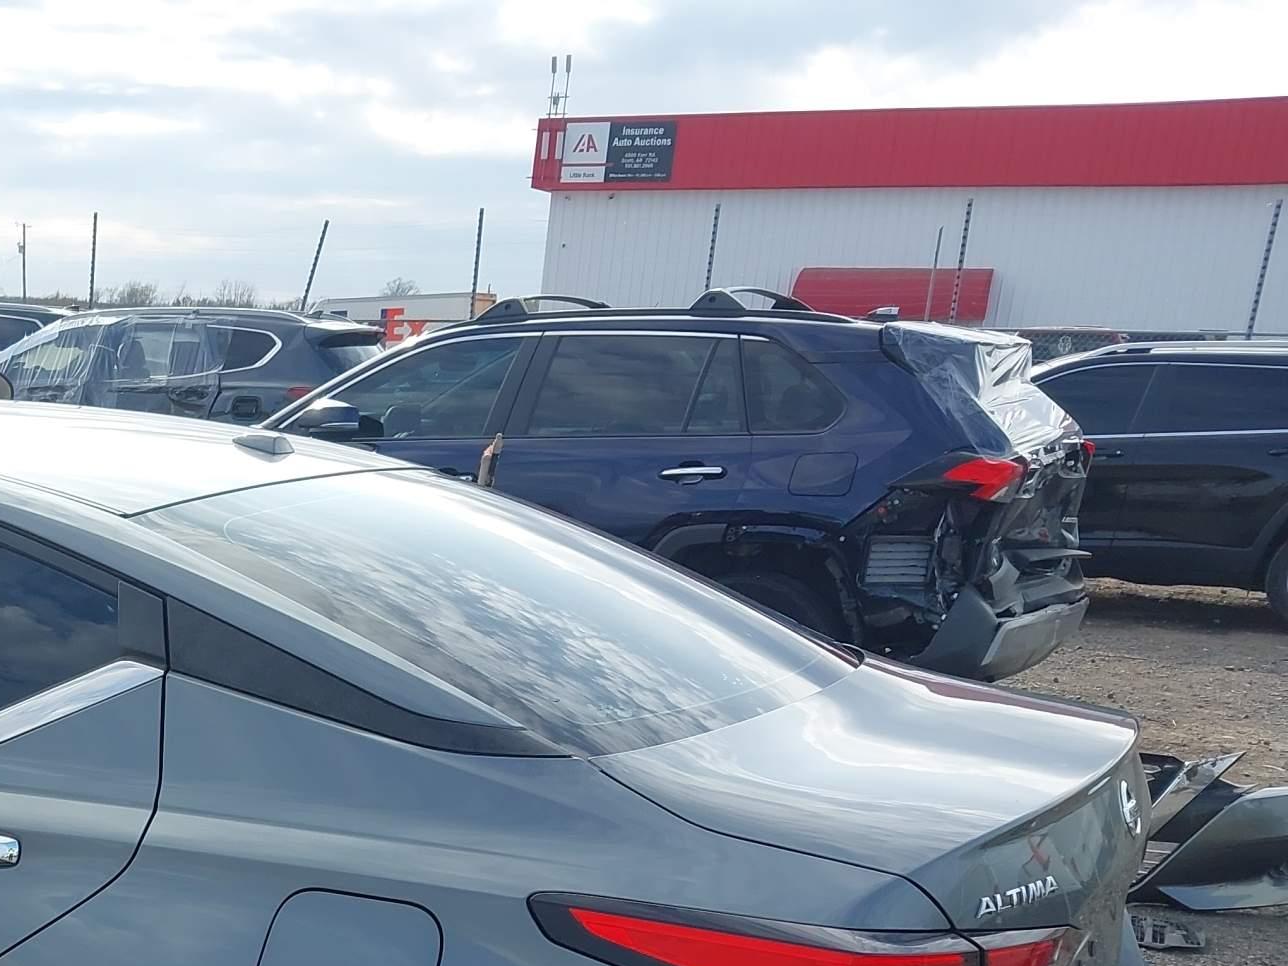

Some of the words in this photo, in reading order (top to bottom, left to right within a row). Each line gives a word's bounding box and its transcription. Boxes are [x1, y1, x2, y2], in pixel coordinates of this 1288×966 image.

[622, 126, 665, 135] Insurance
[612, 137, 632, 146] Auto
[634, 136, 672, 146] Auctions
[976, 875, 1059, 919] ALTIMA
